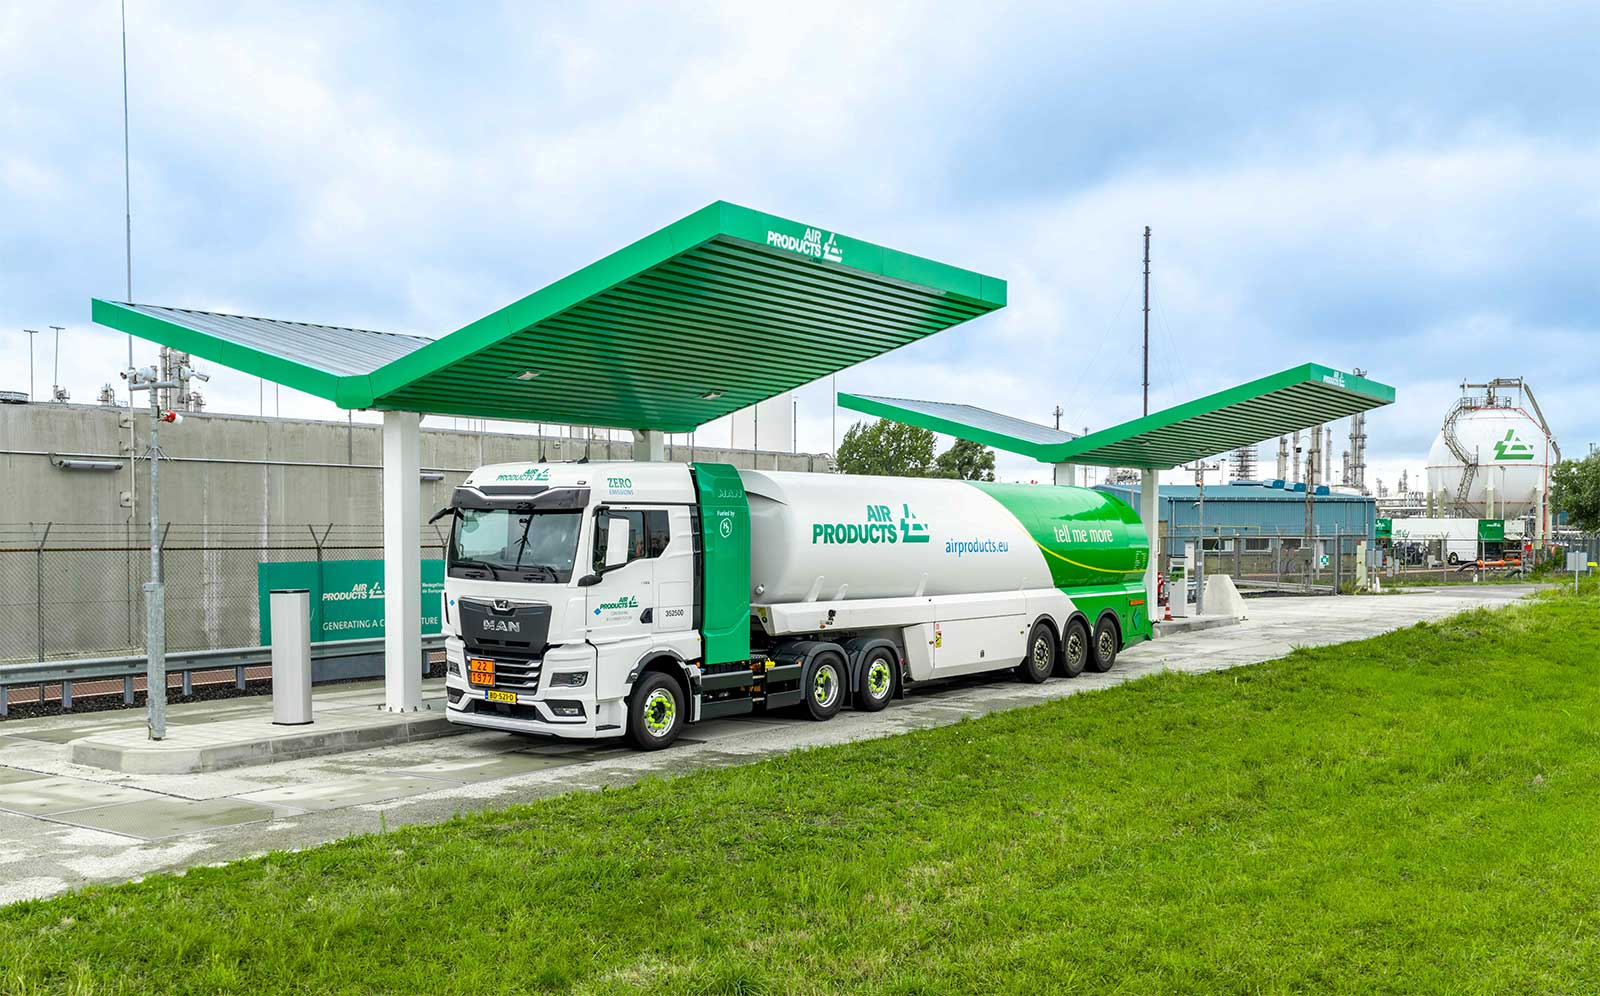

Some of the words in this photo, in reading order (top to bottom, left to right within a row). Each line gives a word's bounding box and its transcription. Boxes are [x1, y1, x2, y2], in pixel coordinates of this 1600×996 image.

[804, 227, 822, 244] AIR
[766, 230, 822, 257] PRODUCTS
[607, 478, 632, 488] ZERO
[718, 488, 743, 498] MAN
[866, 504, 893, 522] AIR
[812, 523, 898, 544] PRODUCTS
[1053, 524, 1071, 543] tell
[1072, 529, 1088, 543] me
[1089, 529, 1114, 543] more
[945, 538, 1009, 557] airproducts.eu
[352, 583, 368, 592] AIR
[322, 591, 368, 601] PRODUCTS
[600, 602, 628, 610] PRODUCTS
[665, 609, 684, 617] 352500
[322, 619, 371, 631] GENERATING
[371, 620, 379, 628] A
[421, 616, 438, 625] TURE
[483, 619, 520, 632] MAN
[477, 661, 487, 671] 22
[473, 673, 492, 683] 1977
